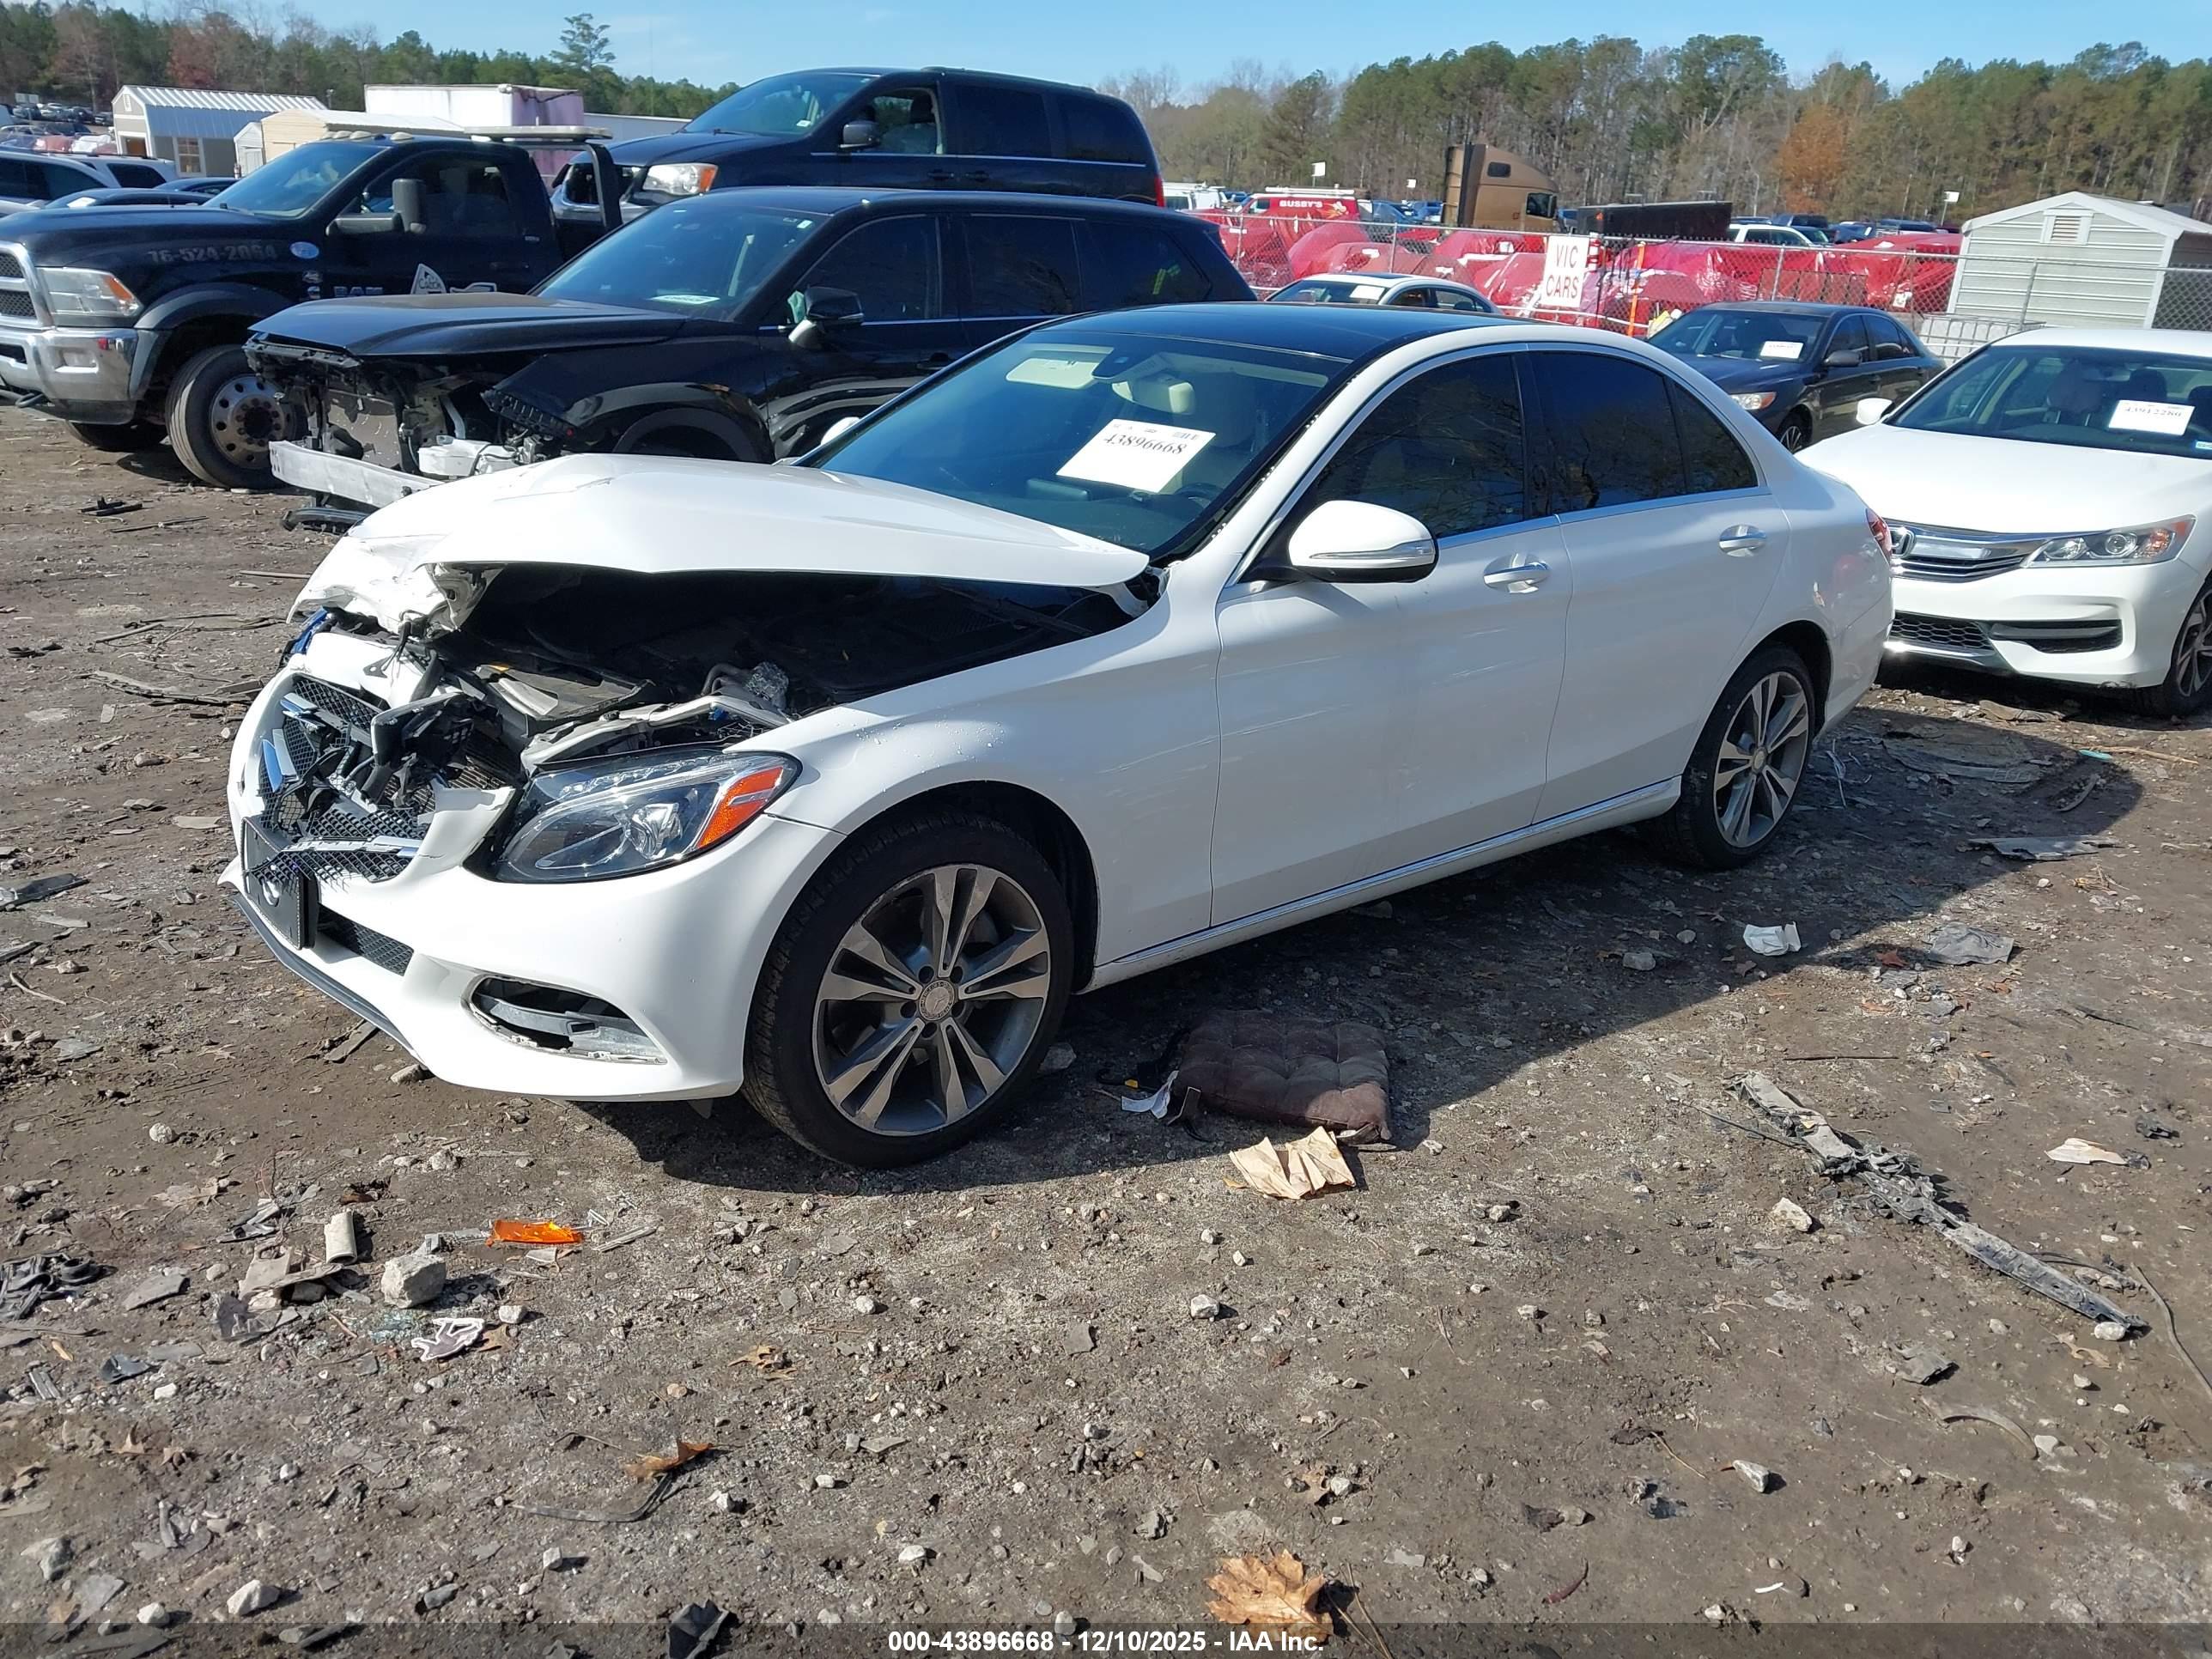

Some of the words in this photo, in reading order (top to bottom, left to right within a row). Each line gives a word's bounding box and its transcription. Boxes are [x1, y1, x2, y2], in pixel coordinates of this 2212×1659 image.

[1556, 245, 1578, 268] VIC
[1547, 275, 1579, 298] CARS
[1103, 433, 1188, 455] 43896668
